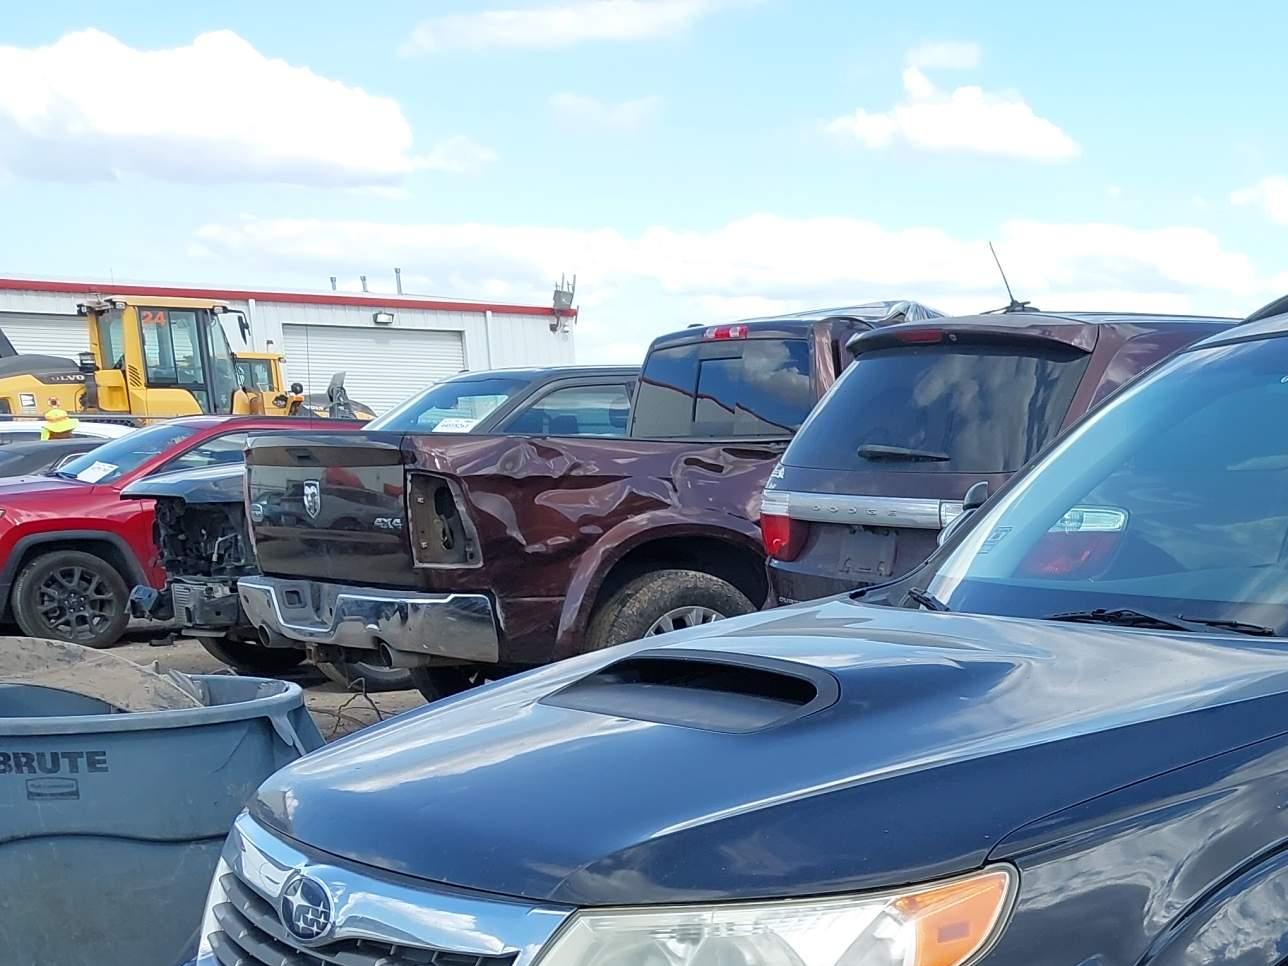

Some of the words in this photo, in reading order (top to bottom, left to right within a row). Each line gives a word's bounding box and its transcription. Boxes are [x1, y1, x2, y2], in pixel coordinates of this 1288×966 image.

[143, 310, 165, 326] 24
[812, 505, 897, 517] DODGE
[0, 751, 109, 774] BRUTE
